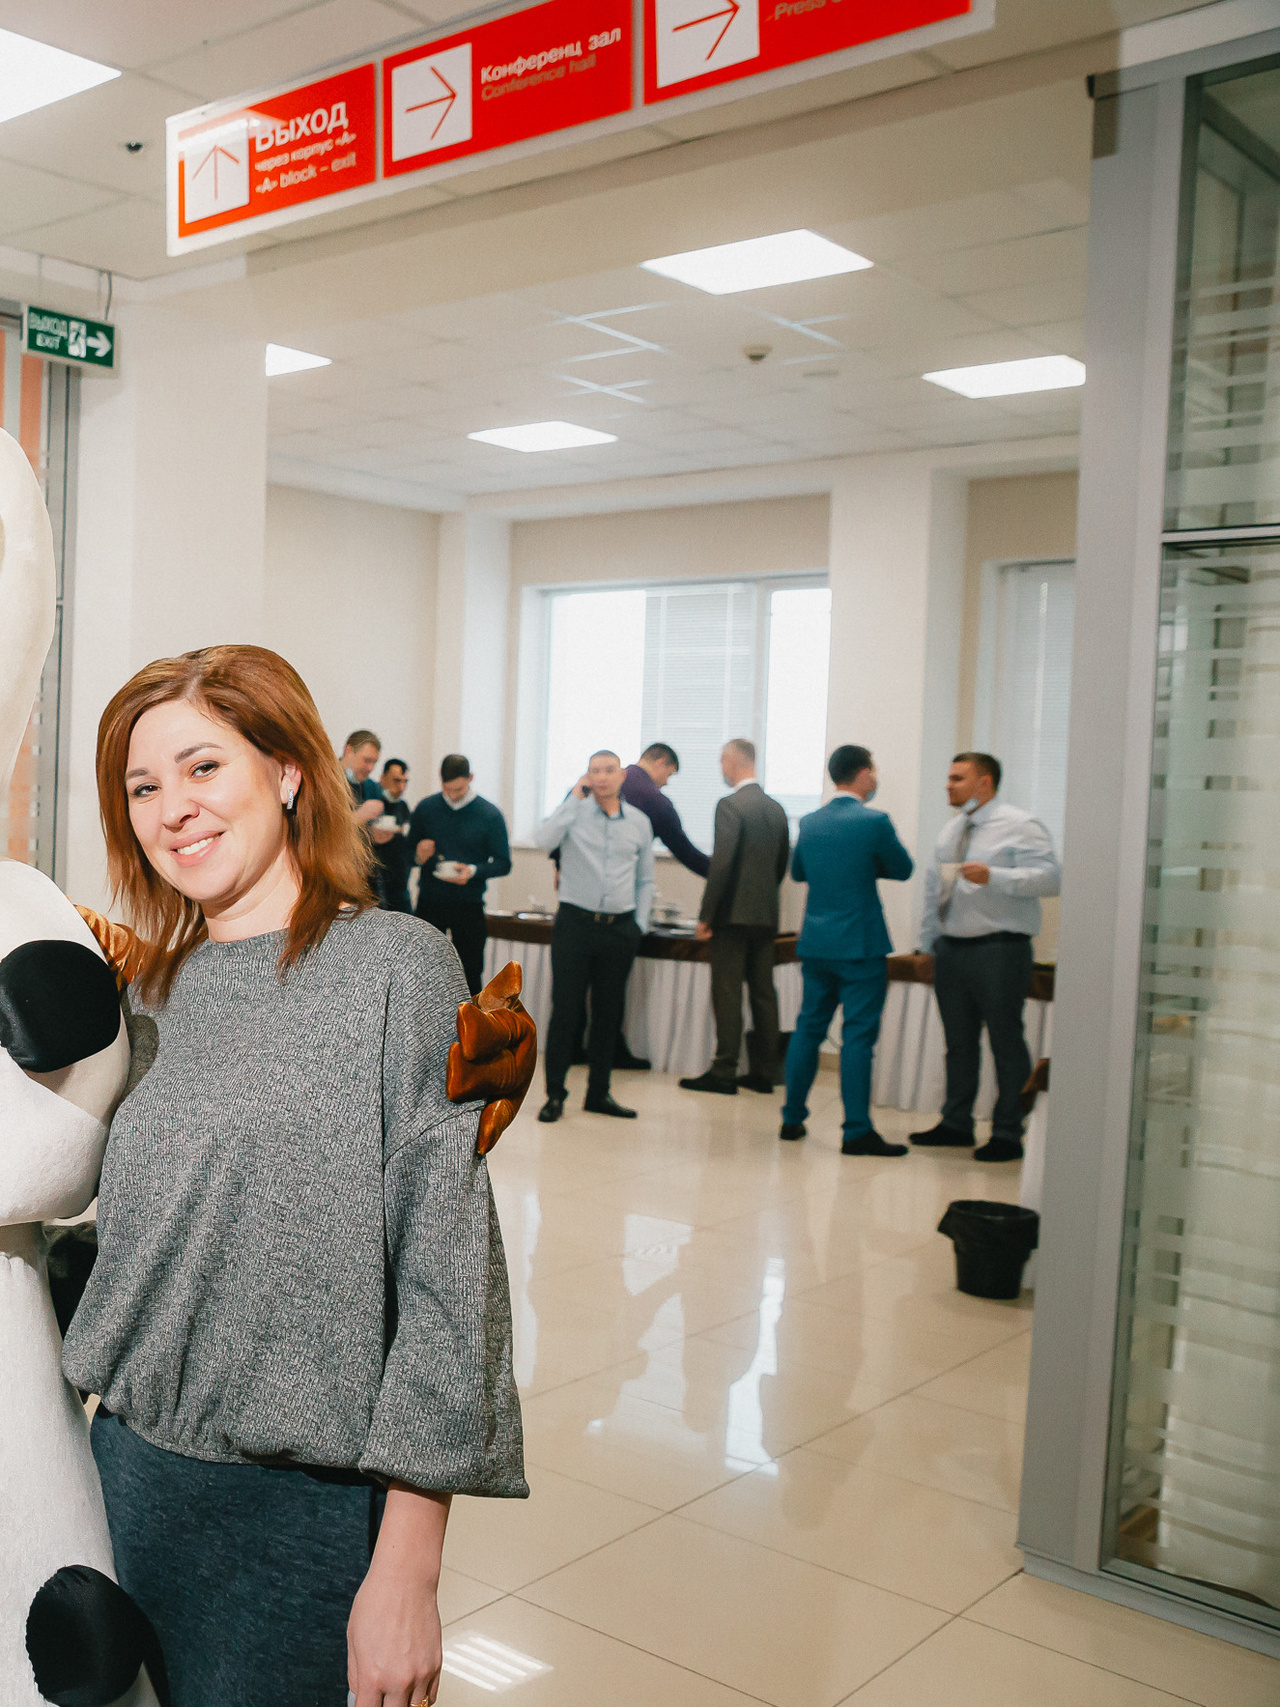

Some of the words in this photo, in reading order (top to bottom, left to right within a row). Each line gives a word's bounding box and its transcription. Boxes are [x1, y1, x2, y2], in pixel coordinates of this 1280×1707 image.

[481, 40, 582, 84] Конференц
[588, 27, 622, 51] зал
[481, 66, 566, 101] Conference
[569, 53, 596, 73] hall
[291, 138, 334, 160] корпус
[280, 164, 317, 188] block
[331, 152, 356, 172] exit
[36, 332, 61, 350] EXIT
